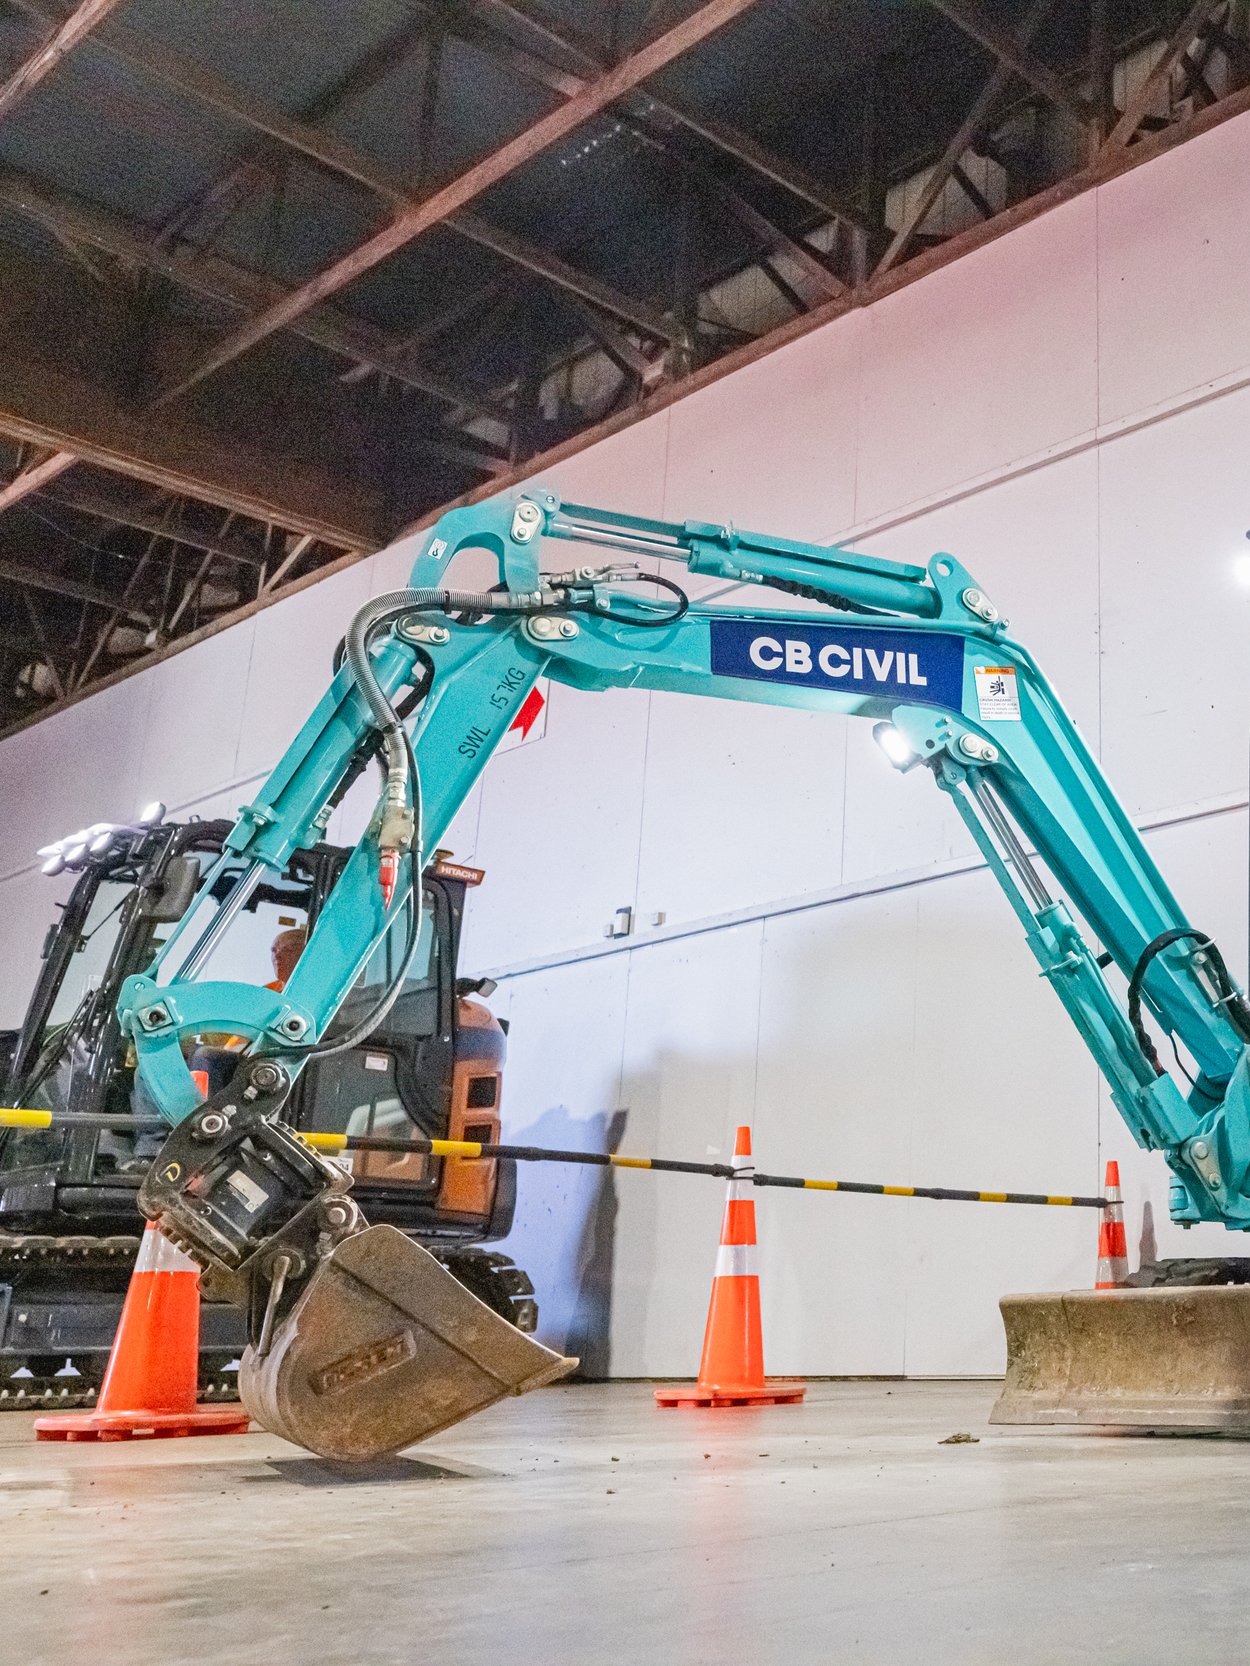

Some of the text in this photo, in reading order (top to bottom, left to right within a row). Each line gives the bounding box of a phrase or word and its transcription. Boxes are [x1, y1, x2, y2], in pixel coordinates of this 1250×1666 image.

[749, 636, 927, 686] CB CIVIL
[458, 726, 492, 759] SWL
[441, 865, 478, 880] HITACHI
